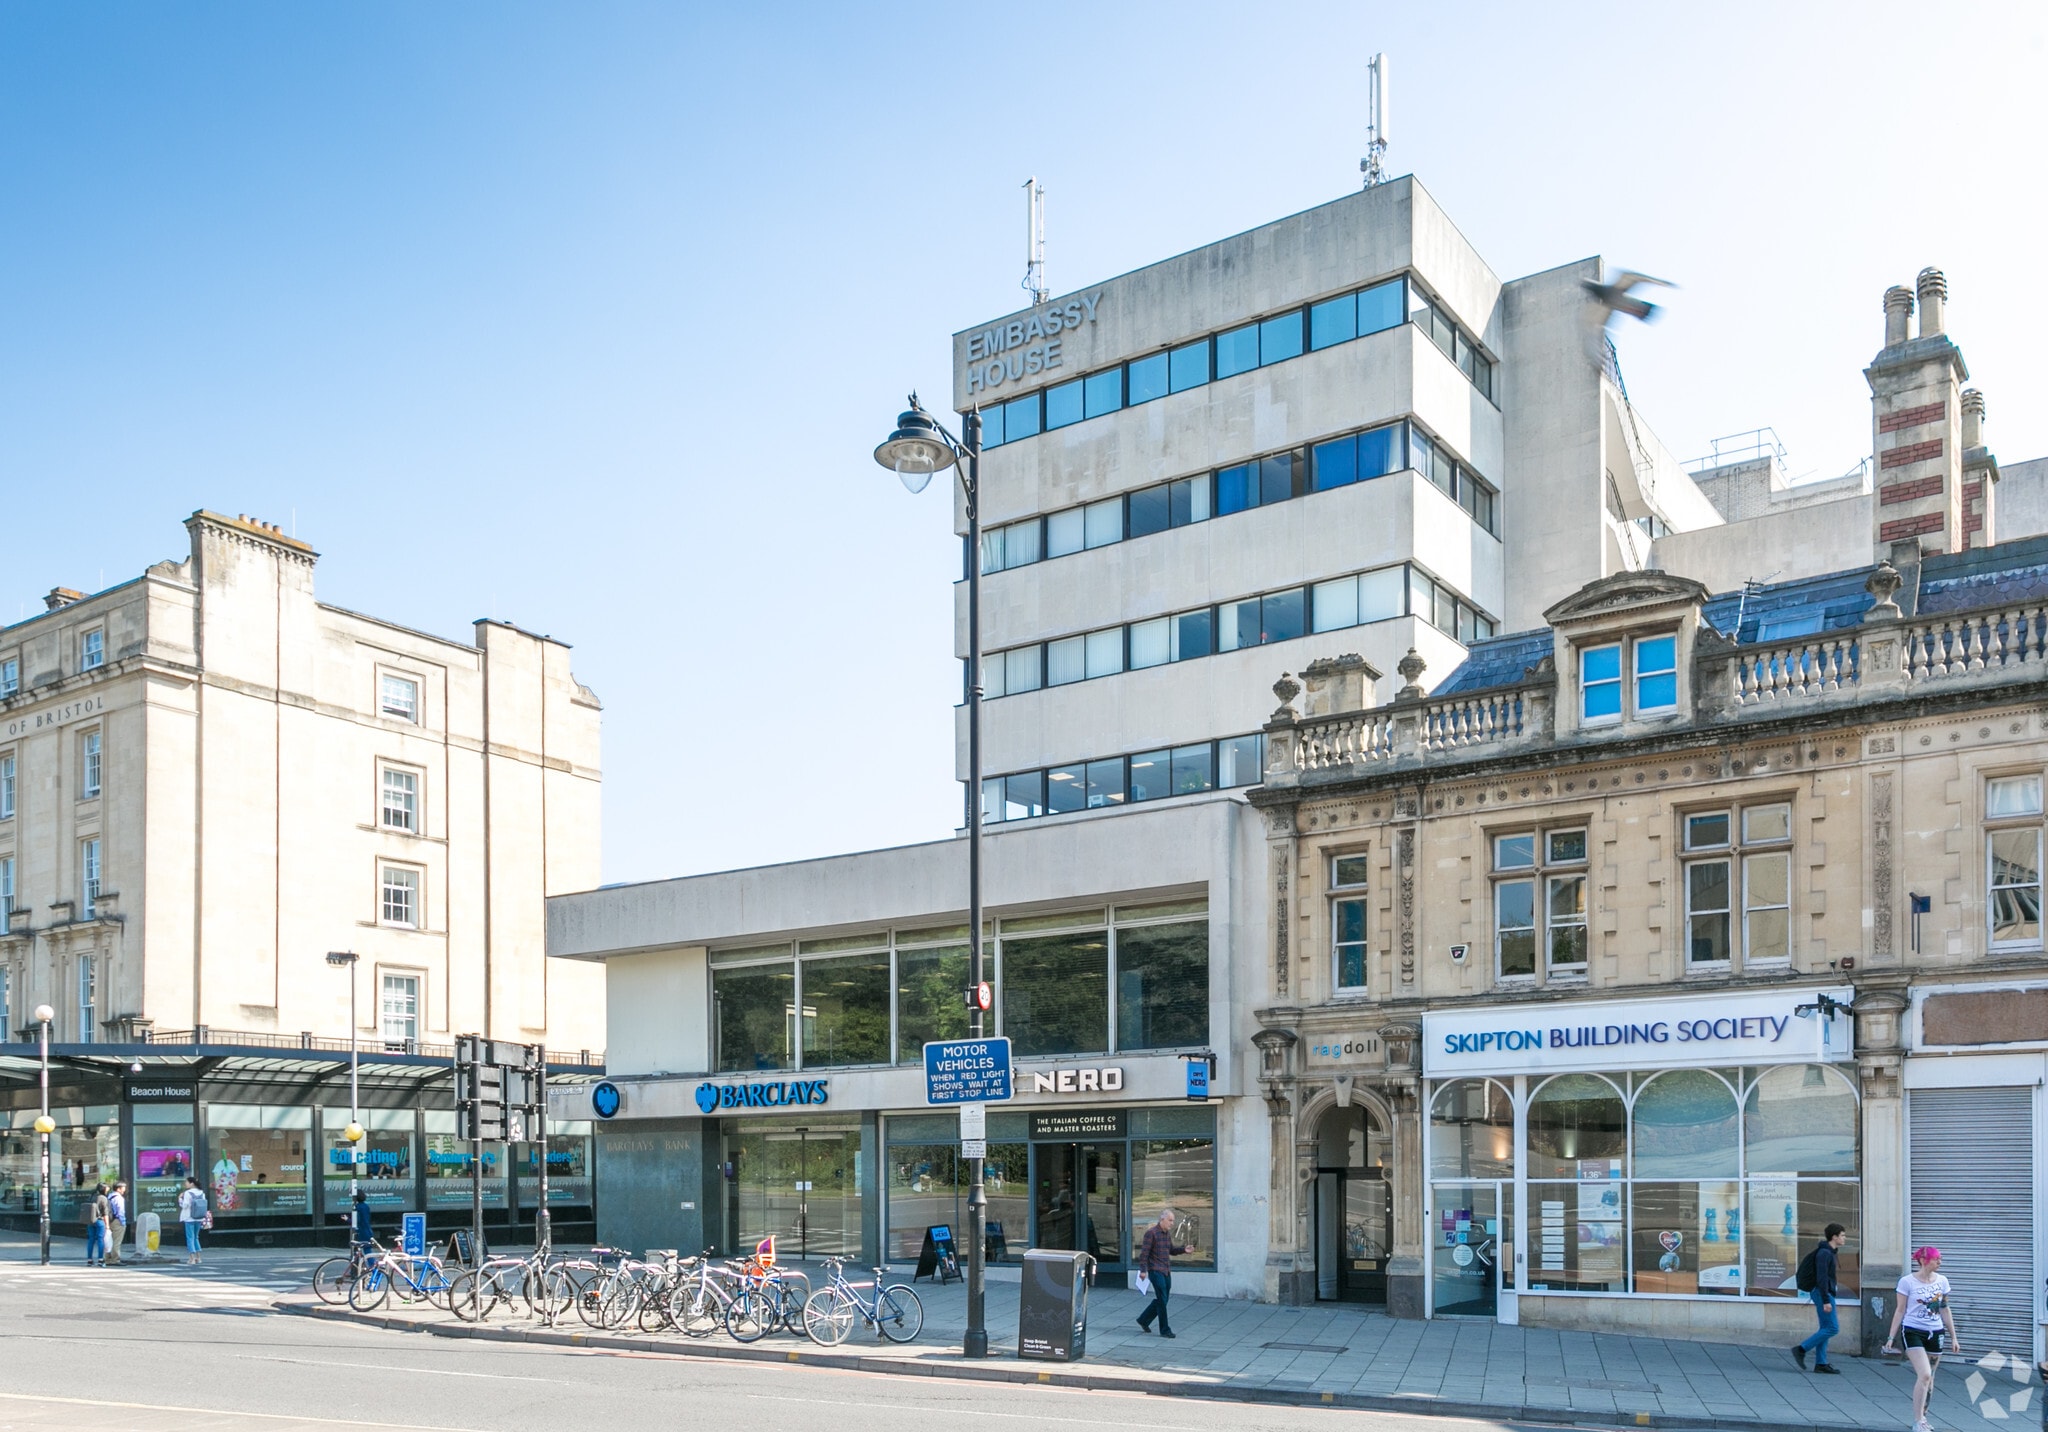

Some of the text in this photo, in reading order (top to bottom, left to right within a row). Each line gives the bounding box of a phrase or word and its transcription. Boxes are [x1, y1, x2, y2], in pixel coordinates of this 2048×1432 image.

[966, 292, 1103, 363] EMBASSY
[966, 339, 1062, 395] HOUSE
[9, 696, 103, 736] OF BRISTOL
[1445, 1015, 1789, 1054] SKIPTON BUILDING SOCIETY
[943, 1044, 988, 1058] MOTOR
[1312, 1039, 1377, 1059] ragdoll
[936, 1057, 995, 1072] VEHICLES
[930, 1070, 1006, 1082] WHEN RED LIGHT
[1034, 1067, 1124, 1094] NERO
[131, 1086, 191, 1097] Beacon House
[933, 1079, 1003, 1091] SHOWS WAIT AT
[720, 1079, 828, 1109] BARCLAYS
[931, 1087, 1005, 1100] FIRST STOP LINE
[1054, 1125, 1080, 1133] MASTER
[1082, 1124, 1117, 1132] ROASTERS
[606, 1139, 691, 1153] BARCLAYS BANK
